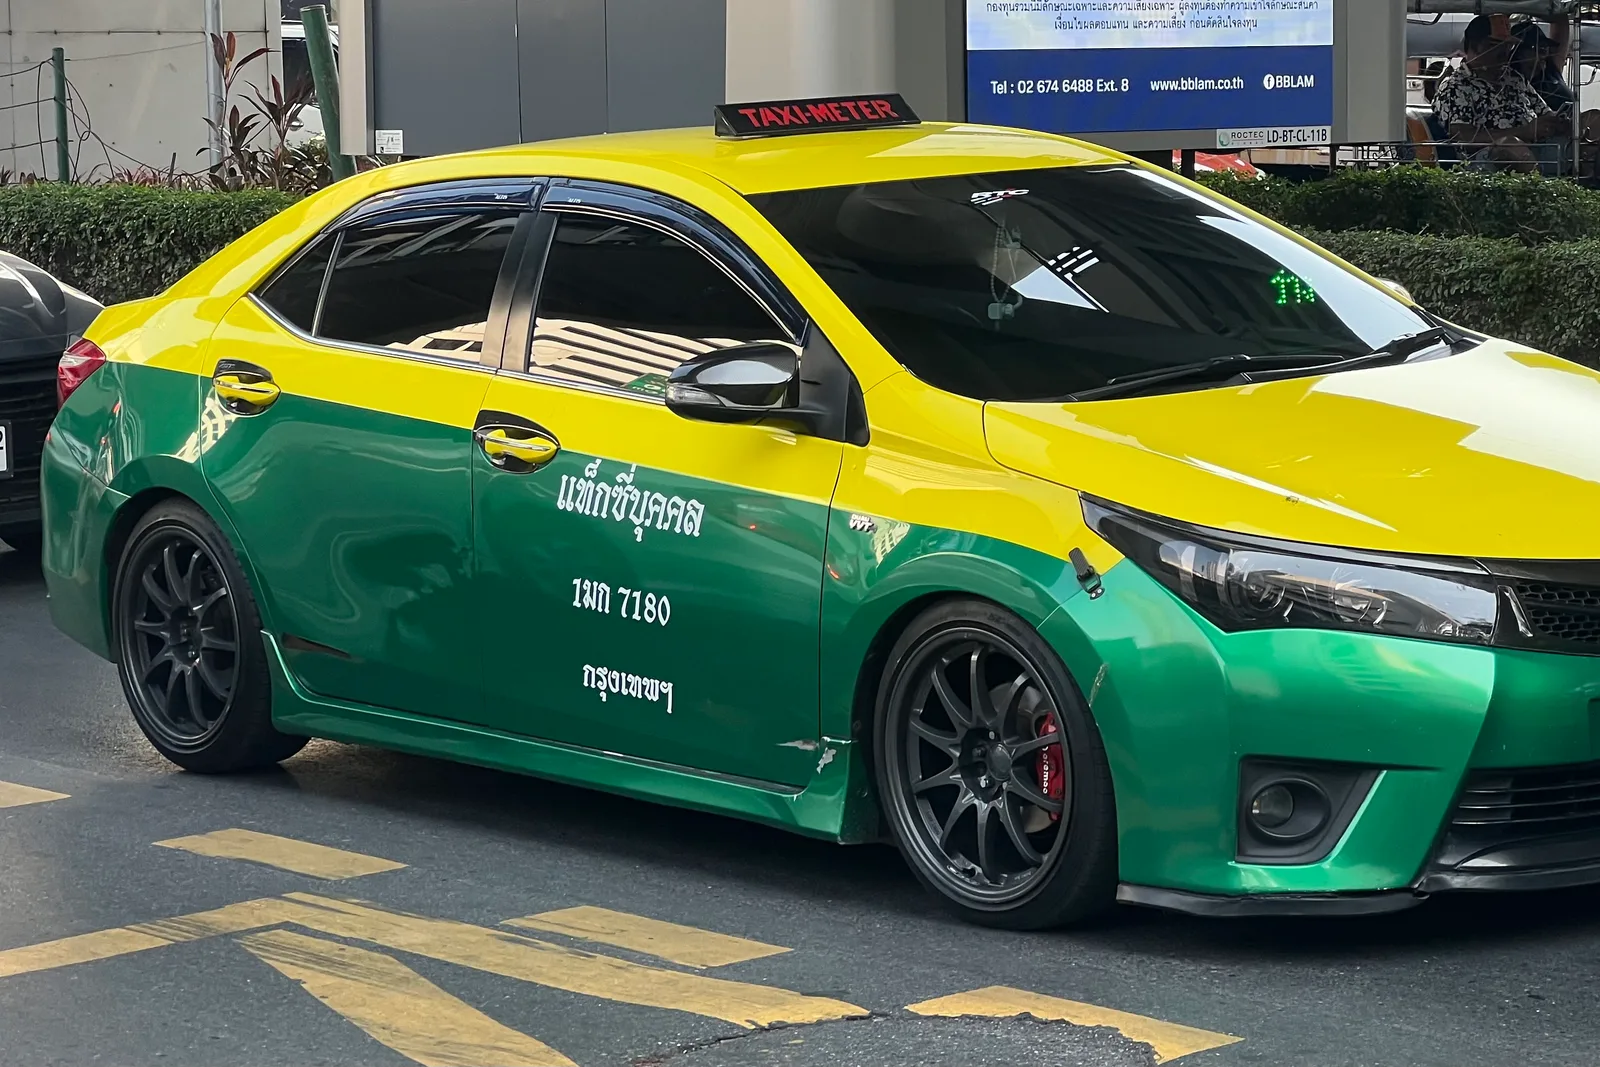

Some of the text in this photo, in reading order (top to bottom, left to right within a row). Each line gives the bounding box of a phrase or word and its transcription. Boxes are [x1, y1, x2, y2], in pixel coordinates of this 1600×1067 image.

[986, 0, 1175, 17] กองทุนรวมนมลกษณะเฉพาะและความเสยงเฉพาะ
[989, 80, 1008, 95] Tel
[1017, 80, 1034, 94] 02
[1036, 79, 1060, 94] 674
[1062, 79, 1094, 93] 6488
[1096, 78, 1119, 92] Ext.
[1120, 78, 1130, 92] 8
[1150, 76, 1244, 91] www.bblam.co.th
[1275, 74, 1314, 89] BBLAM
[738, 100, 899, 127] TAXI-METER
[1230, 131, 1264, 139] ROCTEC
[1267, 128, 1328, 144] LD-BT-CL-11B
[556, 459, 705, 542] แท็กซี่บุคคล
[572, 577, 671, 627] 1มก 7180
[582, 664, 674, 714] กรุงเทพฯ
